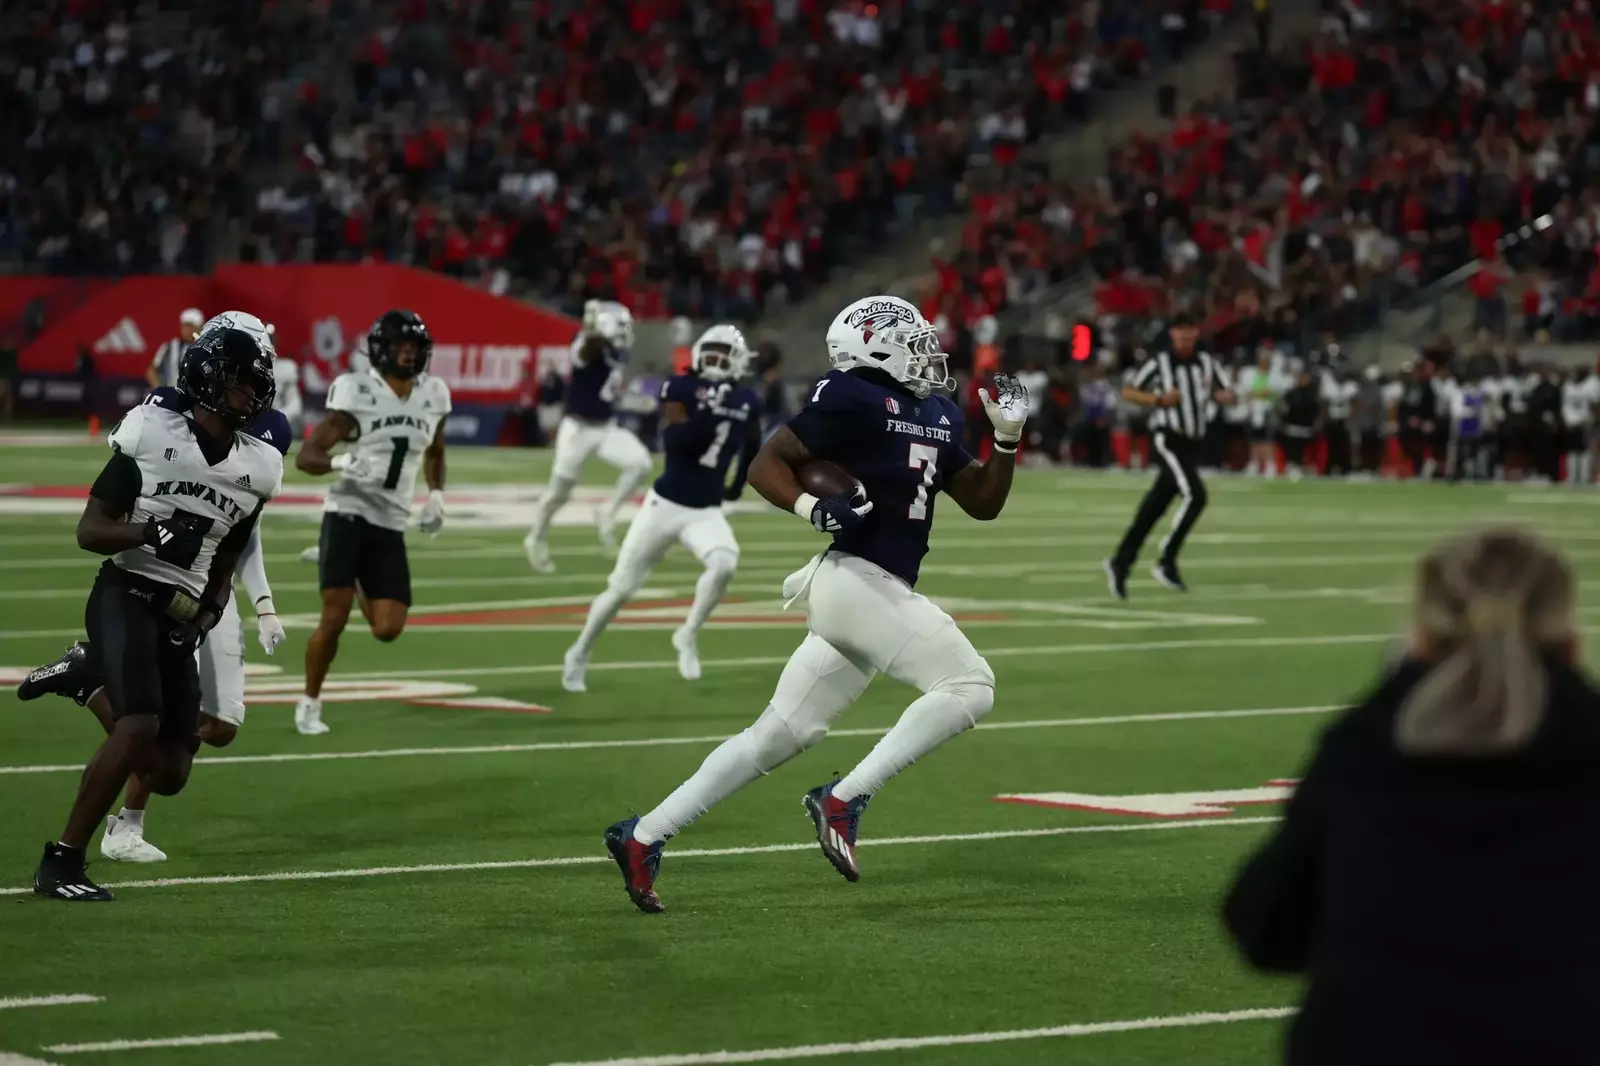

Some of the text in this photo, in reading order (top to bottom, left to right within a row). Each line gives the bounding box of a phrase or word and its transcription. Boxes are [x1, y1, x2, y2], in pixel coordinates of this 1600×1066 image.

[850, 302, 915, 327] Bulldogs
[811, 379, 831, 403] 7
[698, 420, 732, 469] 1
[885, 419, 951, 442] FRESNO STATE
[382, 435, 410, 490] 1
[908, 442, 939, 521] 7
